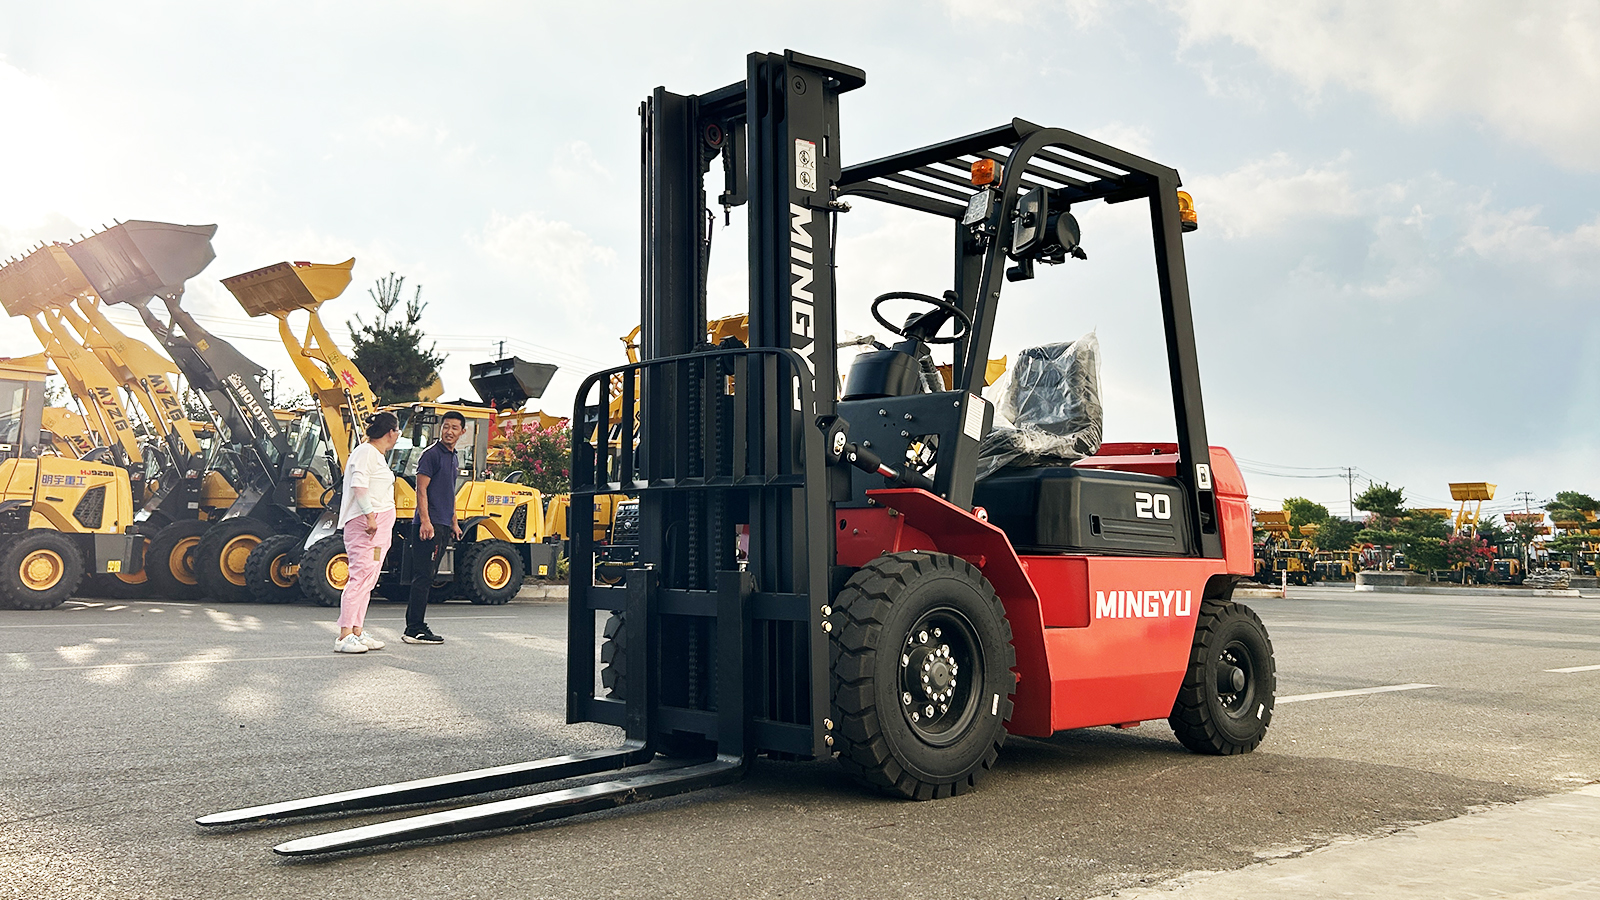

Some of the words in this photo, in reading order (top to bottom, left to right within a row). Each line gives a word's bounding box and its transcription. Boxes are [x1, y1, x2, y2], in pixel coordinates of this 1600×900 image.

[237, 385, 268, 420] MOLOT
[41, 474, 87, 486] 明宇重工
[1135, 492, 1171, 519] 20
[1096, 590, 1191, 618] MINGYU
